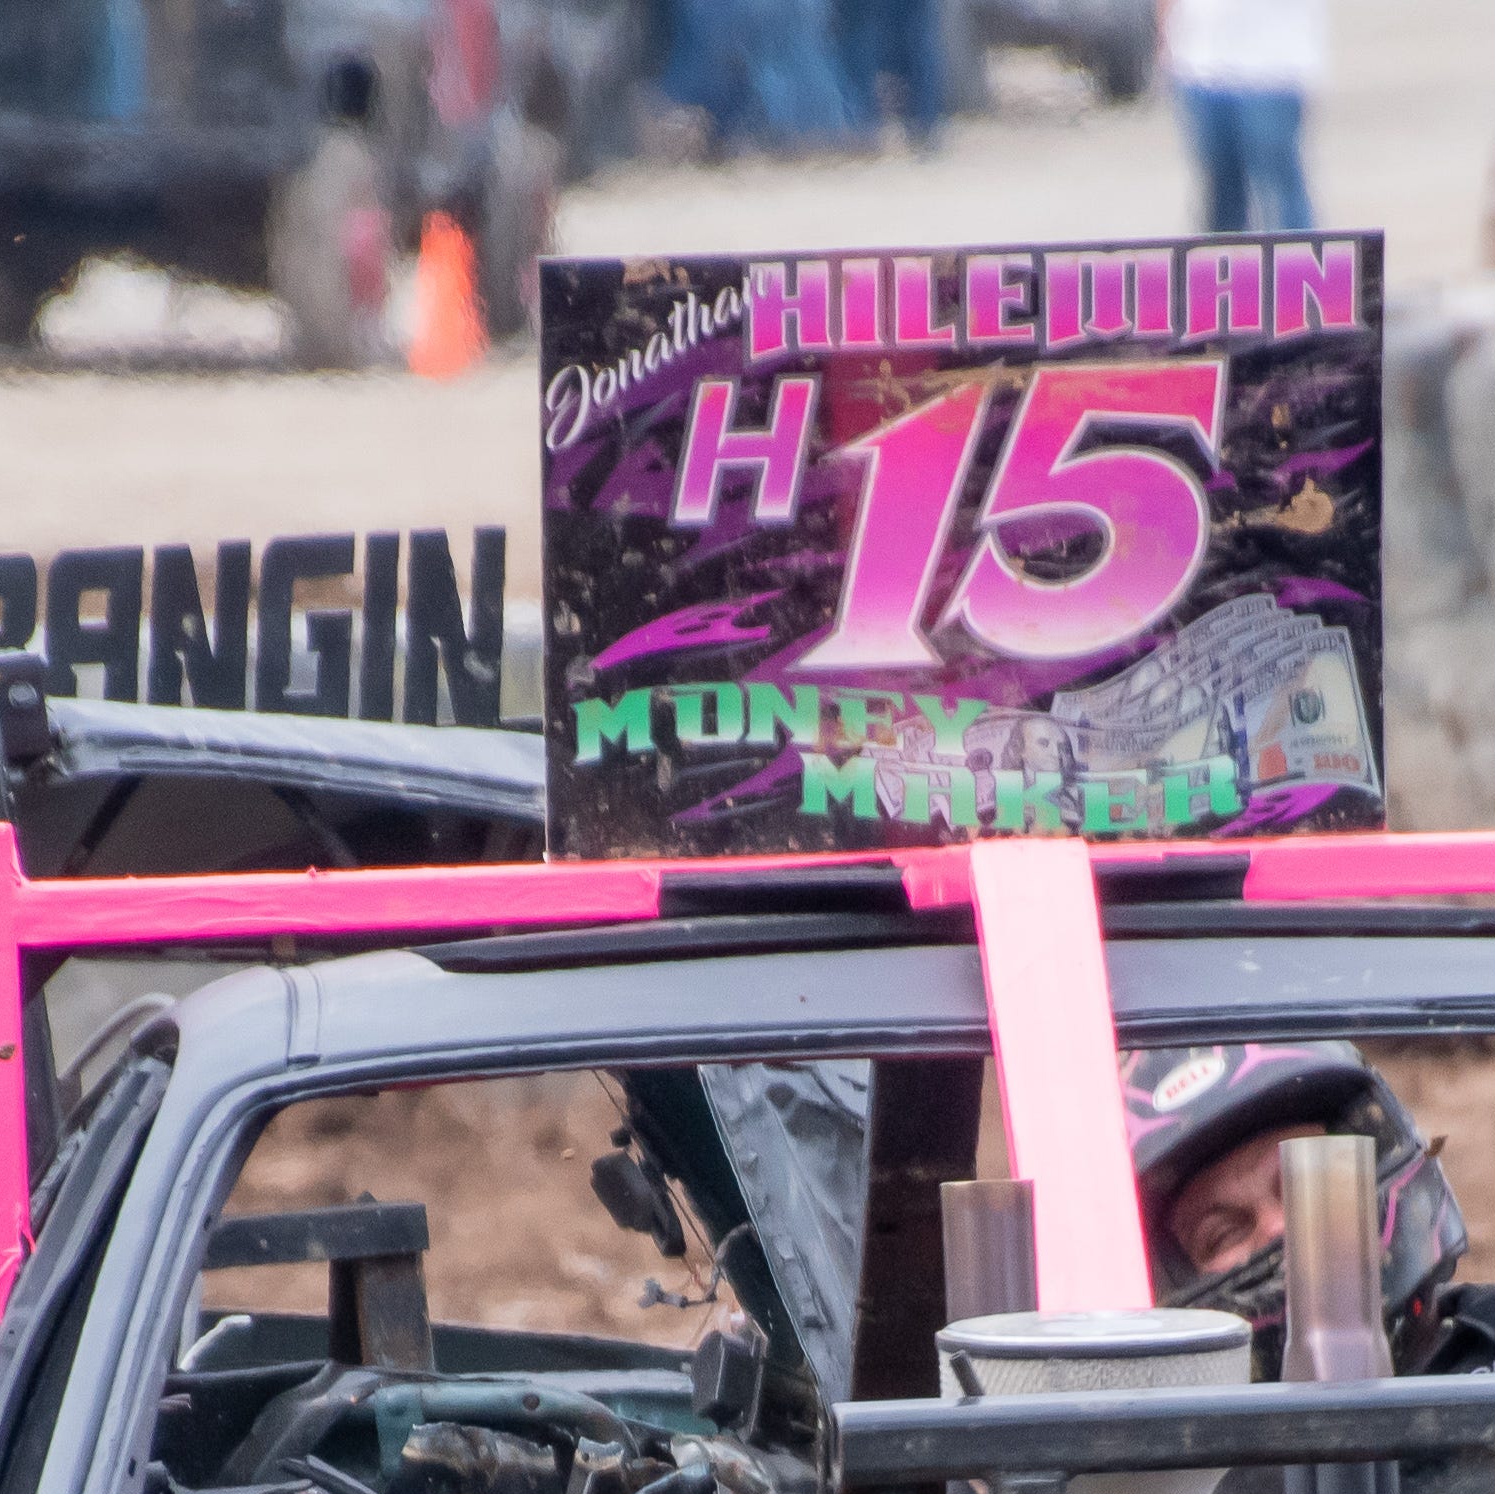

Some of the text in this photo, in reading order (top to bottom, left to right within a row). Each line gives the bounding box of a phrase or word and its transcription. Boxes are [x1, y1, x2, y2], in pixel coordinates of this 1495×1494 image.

[545, 240, 1360, 452] Jonathan HILEMAN
[672, 358, 1228, 672] H 15
[572, 682, 988, 766] MONEY
[799, 750, 1244, 834] MAKER
